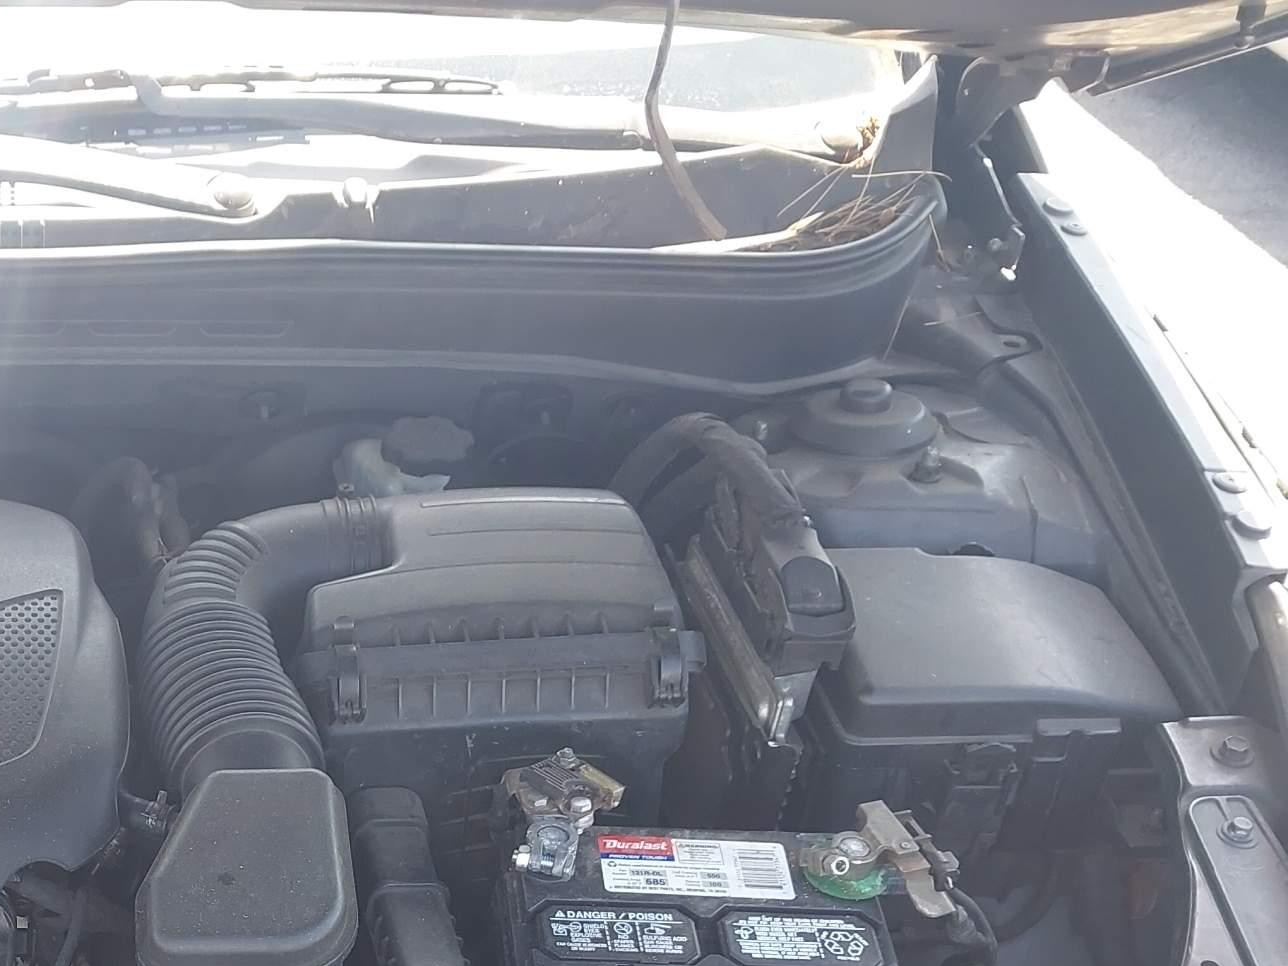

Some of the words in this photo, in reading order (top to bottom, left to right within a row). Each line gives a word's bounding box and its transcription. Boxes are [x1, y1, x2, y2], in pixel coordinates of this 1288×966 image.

[602, 839, 668, 850] Duralast
[645, 878, 666, 886] 685
[567, 911, 616, 919] DANGER
[628, 912, 673, 921] POISON
